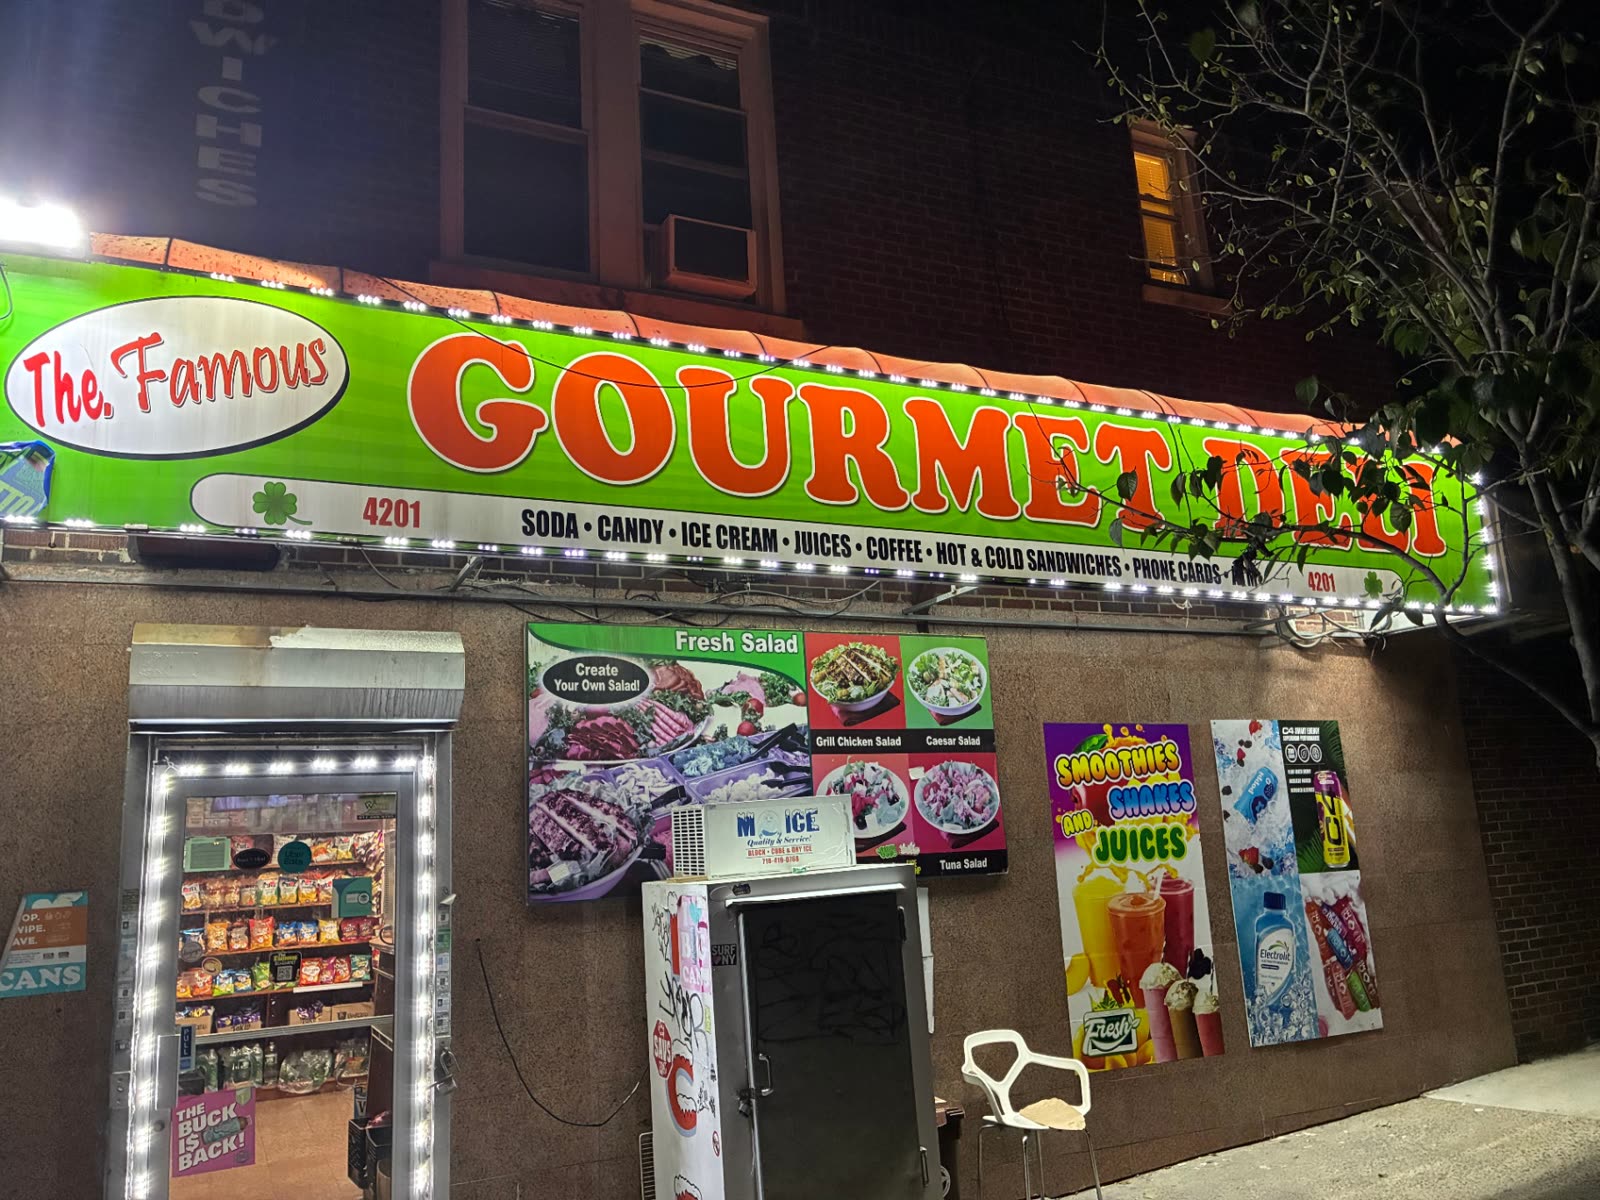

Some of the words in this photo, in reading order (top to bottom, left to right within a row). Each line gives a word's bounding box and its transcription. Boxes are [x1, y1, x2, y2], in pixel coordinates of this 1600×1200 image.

[111, 332, 328, 413] Famous
[407, 332, 1173, 533] GOURMET
[362, 496, 421, 528] 4201
[521, 508, 579, 540] SODA
[597, 514, 664, 546] CANDY
[681, 521, 711, 549] ICE
[715, 523, 778, 554] CREAM
[793, 531, 852, 559] JUICES
[866, 536, 923, 563] COFFEE
[936, 541, 969, 567] HOT
[971, 548, 982, 567] &
[985, 545, 1025, 573] COLD
[1026, 549, 1122, 578] SANDWICHES
[1133, 556, 1177, 583] PHONE
[1178, 559, 1222, 586] CARDS
[1307, 571, 1337, 593] 4201
[675, 630, 735, 652] Fresh
[741, 633, 799, 654] Salad
[575, 662, 619, 677] Create
[554, 679, 579, 692] Your
[581, 679, 606, 692] Own
[607, 679, 640, 692] Salad!
[815, 736, 836, 747] Grill
[837, 736, 874, 747] Chicken
[875, 735, 902, 747] Salad
[926, 735, 957, 746] Caesar
[957, 735, 981, 746] Salad
[1056, 741, 1180, 788] SMOOTHIES
[1108, 781, 1195, 819] SHAKES
[784, 808, 820, 833] ICE
[1062, 811, 1093, 836] AND
[747, 838, 775, 848] Quality
[1095, 826, 1186, 862] JUICES
[939, 859, 962, 870] Tuna
[962, 857, 988, 869] Salad
[711, 944, 736, 957] SURF
[721, 952, 736, 965] NY
[1260, 948, 1291, 962] Electrolit
[1085, 1014, 1132, 1040] Fresh
[182, 1027, 190, 1056] PULL
[176, 1102, 205, 1122] THE
[178, 1102, 237, 1139] BUCK
[178, 1131, 245, 1172] BACK!
